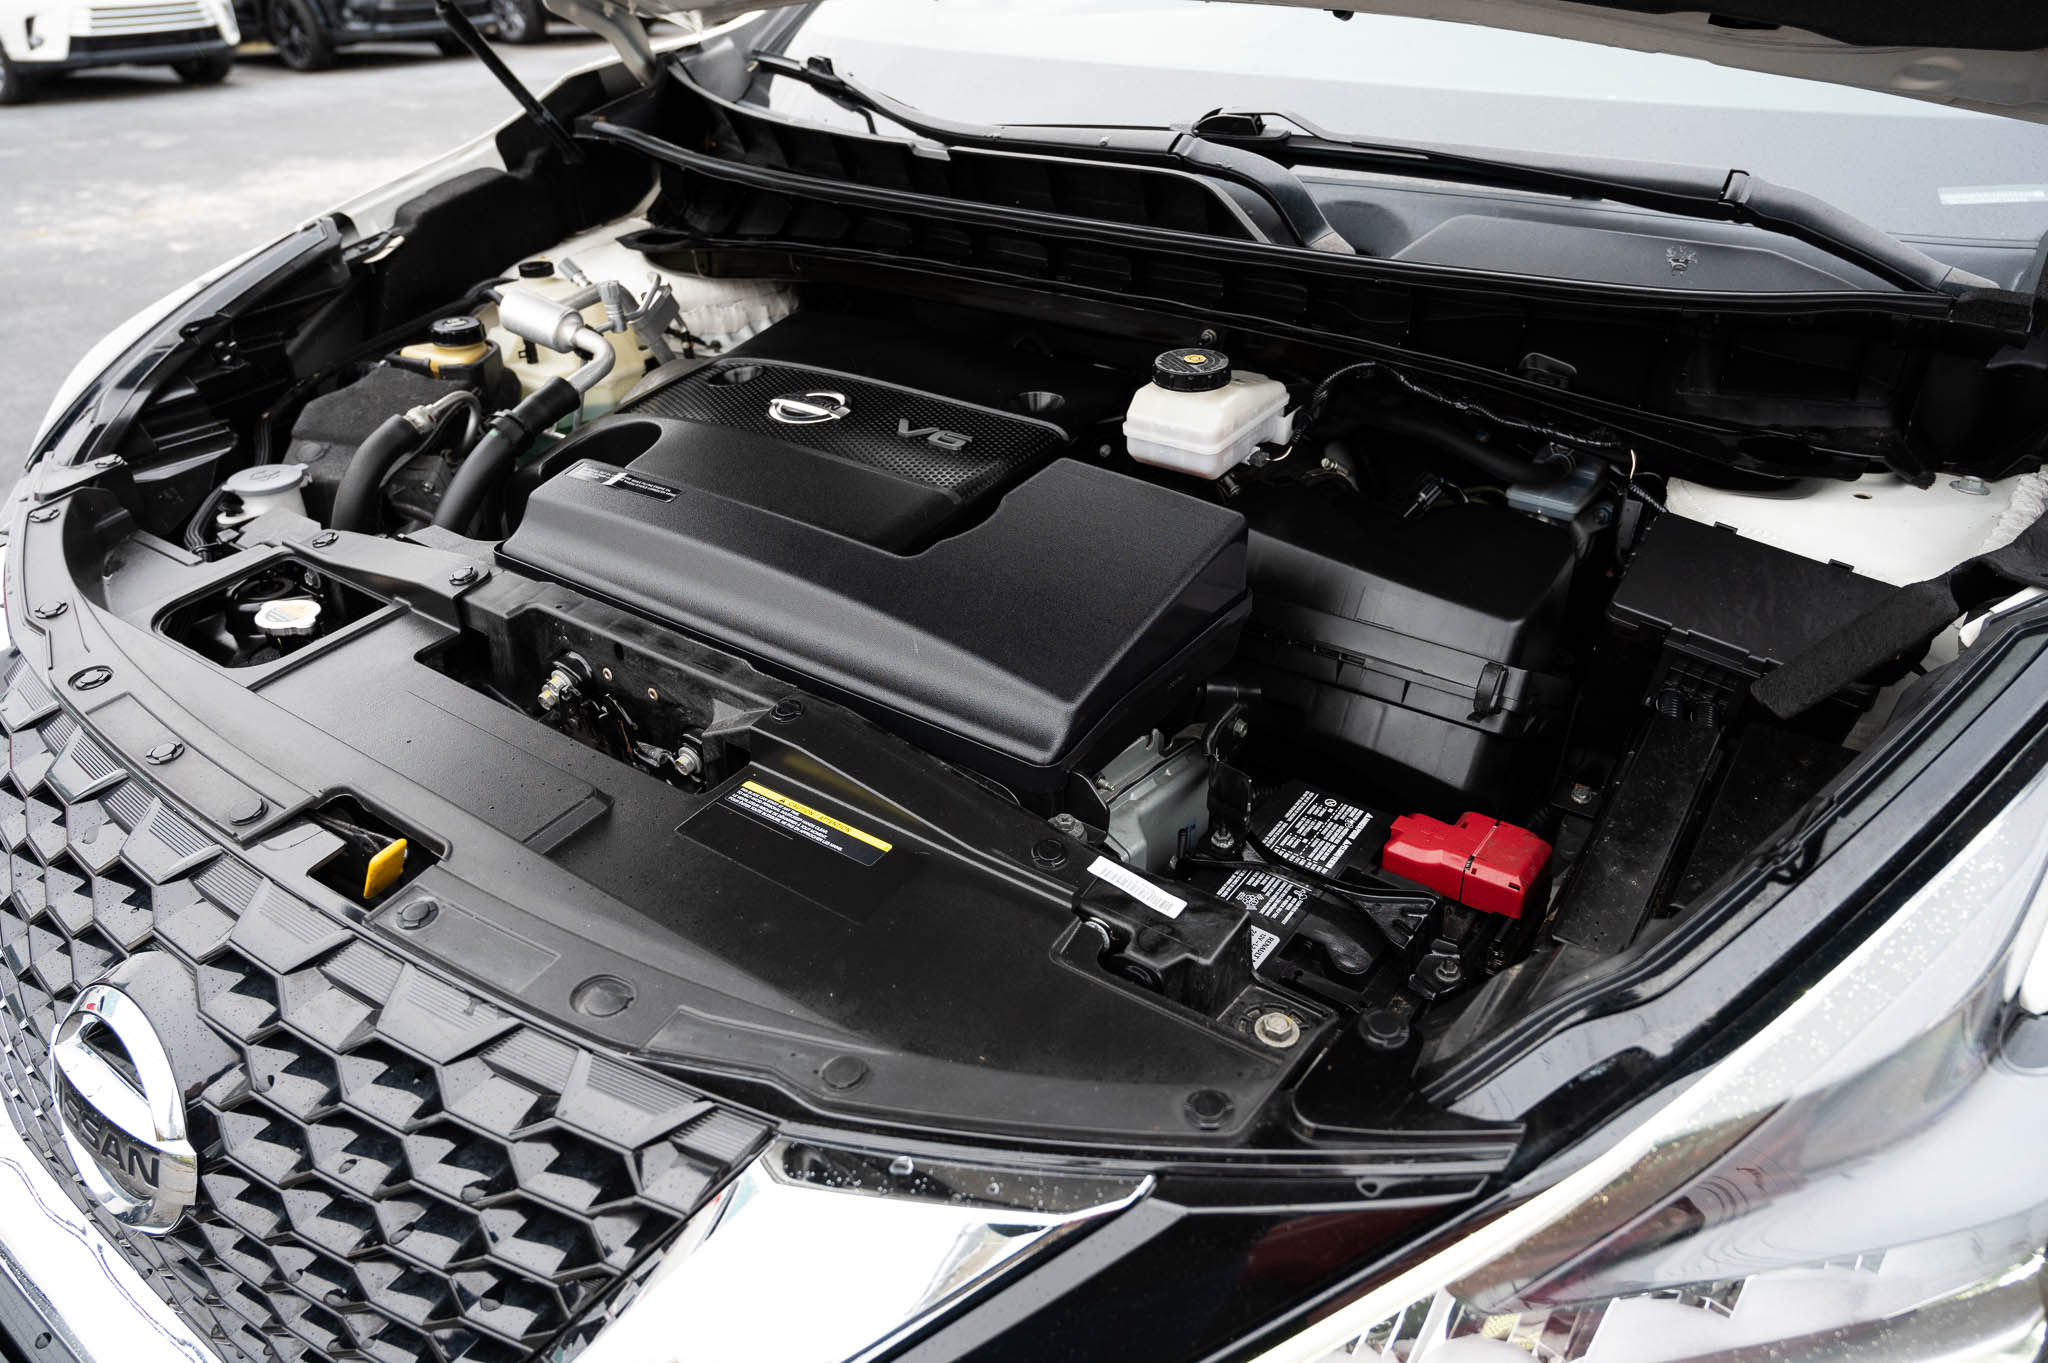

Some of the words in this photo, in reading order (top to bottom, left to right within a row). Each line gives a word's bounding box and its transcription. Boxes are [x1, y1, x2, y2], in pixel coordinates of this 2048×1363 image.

[897, 417, 974, 451] V6
[786, 801, 815, 815] CAUTION
[817, 815, 851, 832] ATTENTION
[1254, 937, 1275, 959] RENAULT
[55, 1073, 160, 1189] ISSAN
